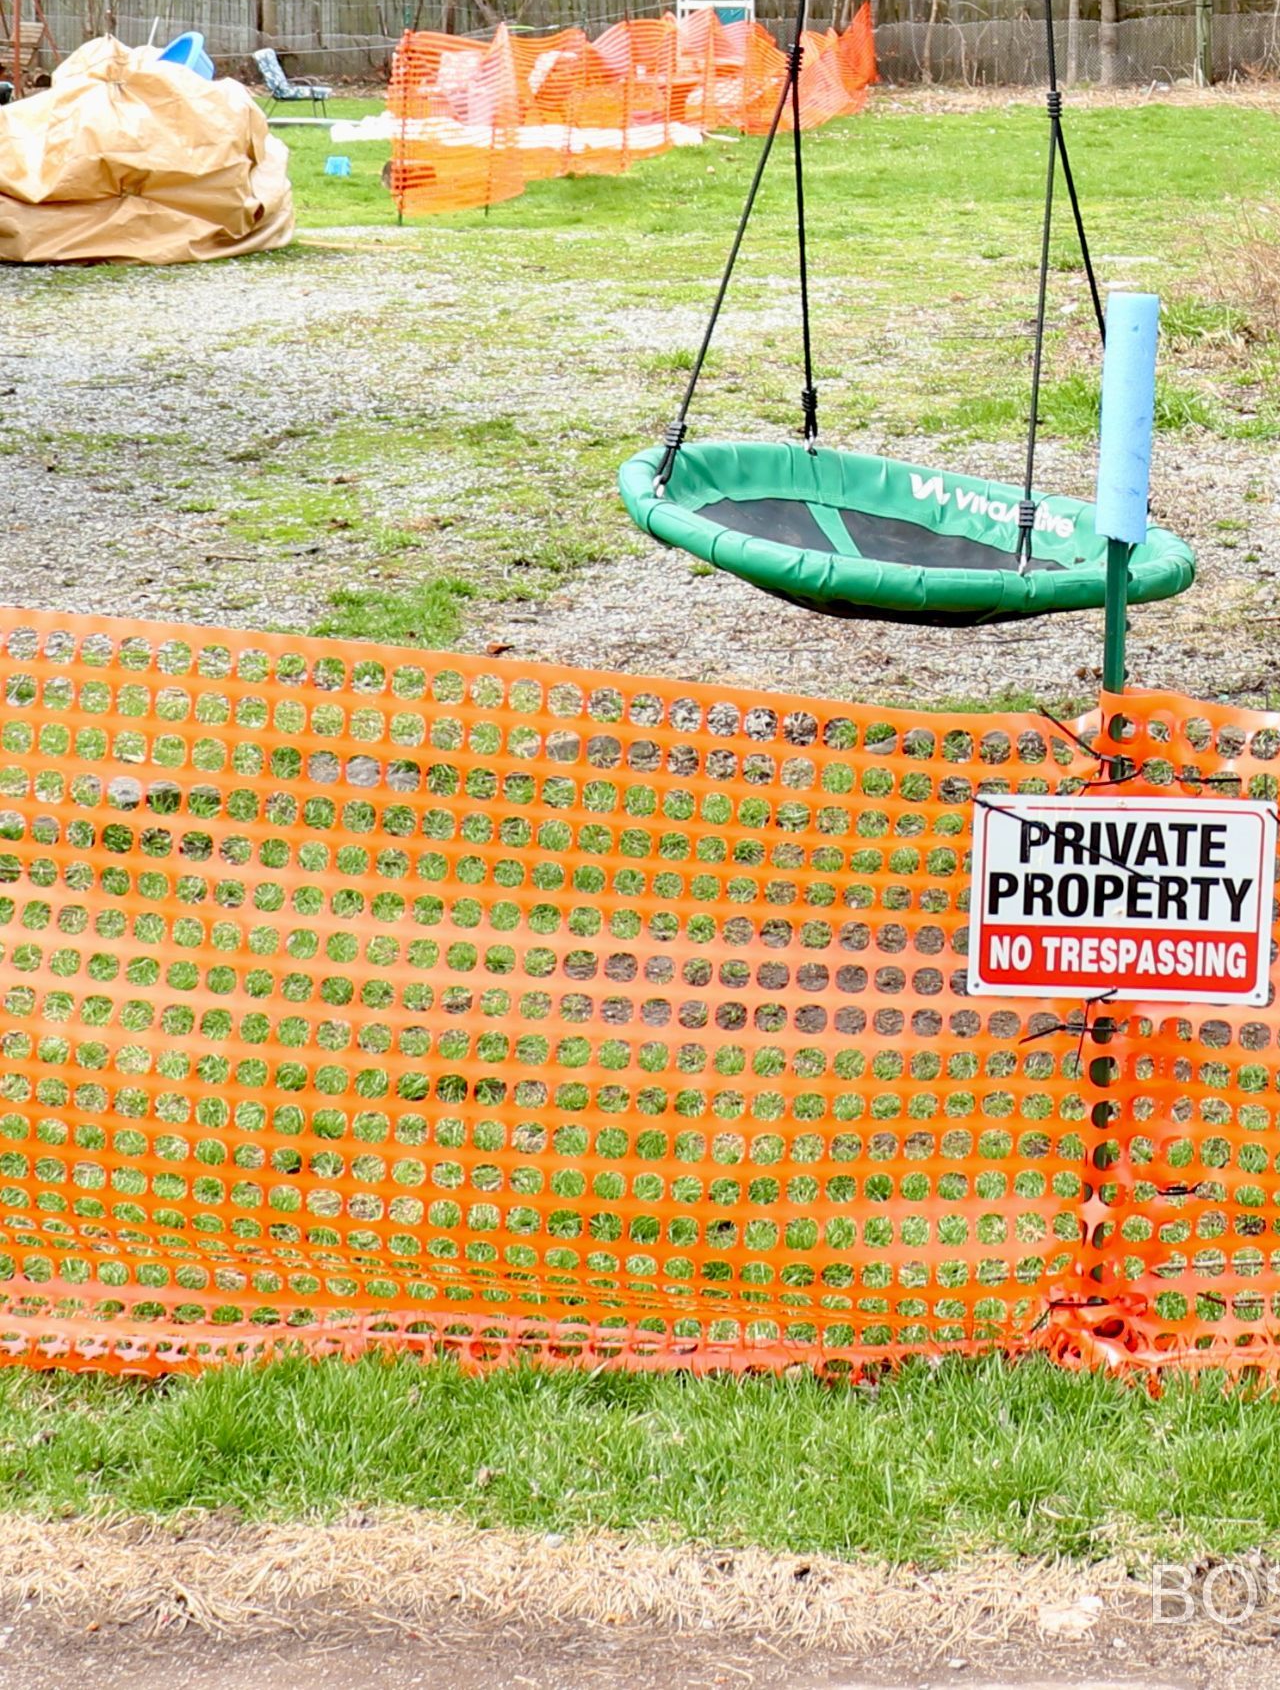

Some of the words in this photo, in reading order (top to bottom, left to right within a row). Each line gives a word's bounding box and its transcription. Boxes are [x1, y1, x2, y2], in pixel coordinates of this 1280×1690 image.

[1019, 820, 1227, 869] PRIVATE
[987, 871, 1254, 923] PROPERTY
[989, 934, 1033, 971] NO
[1041, 935, 1247, 979] TRESPASSING
